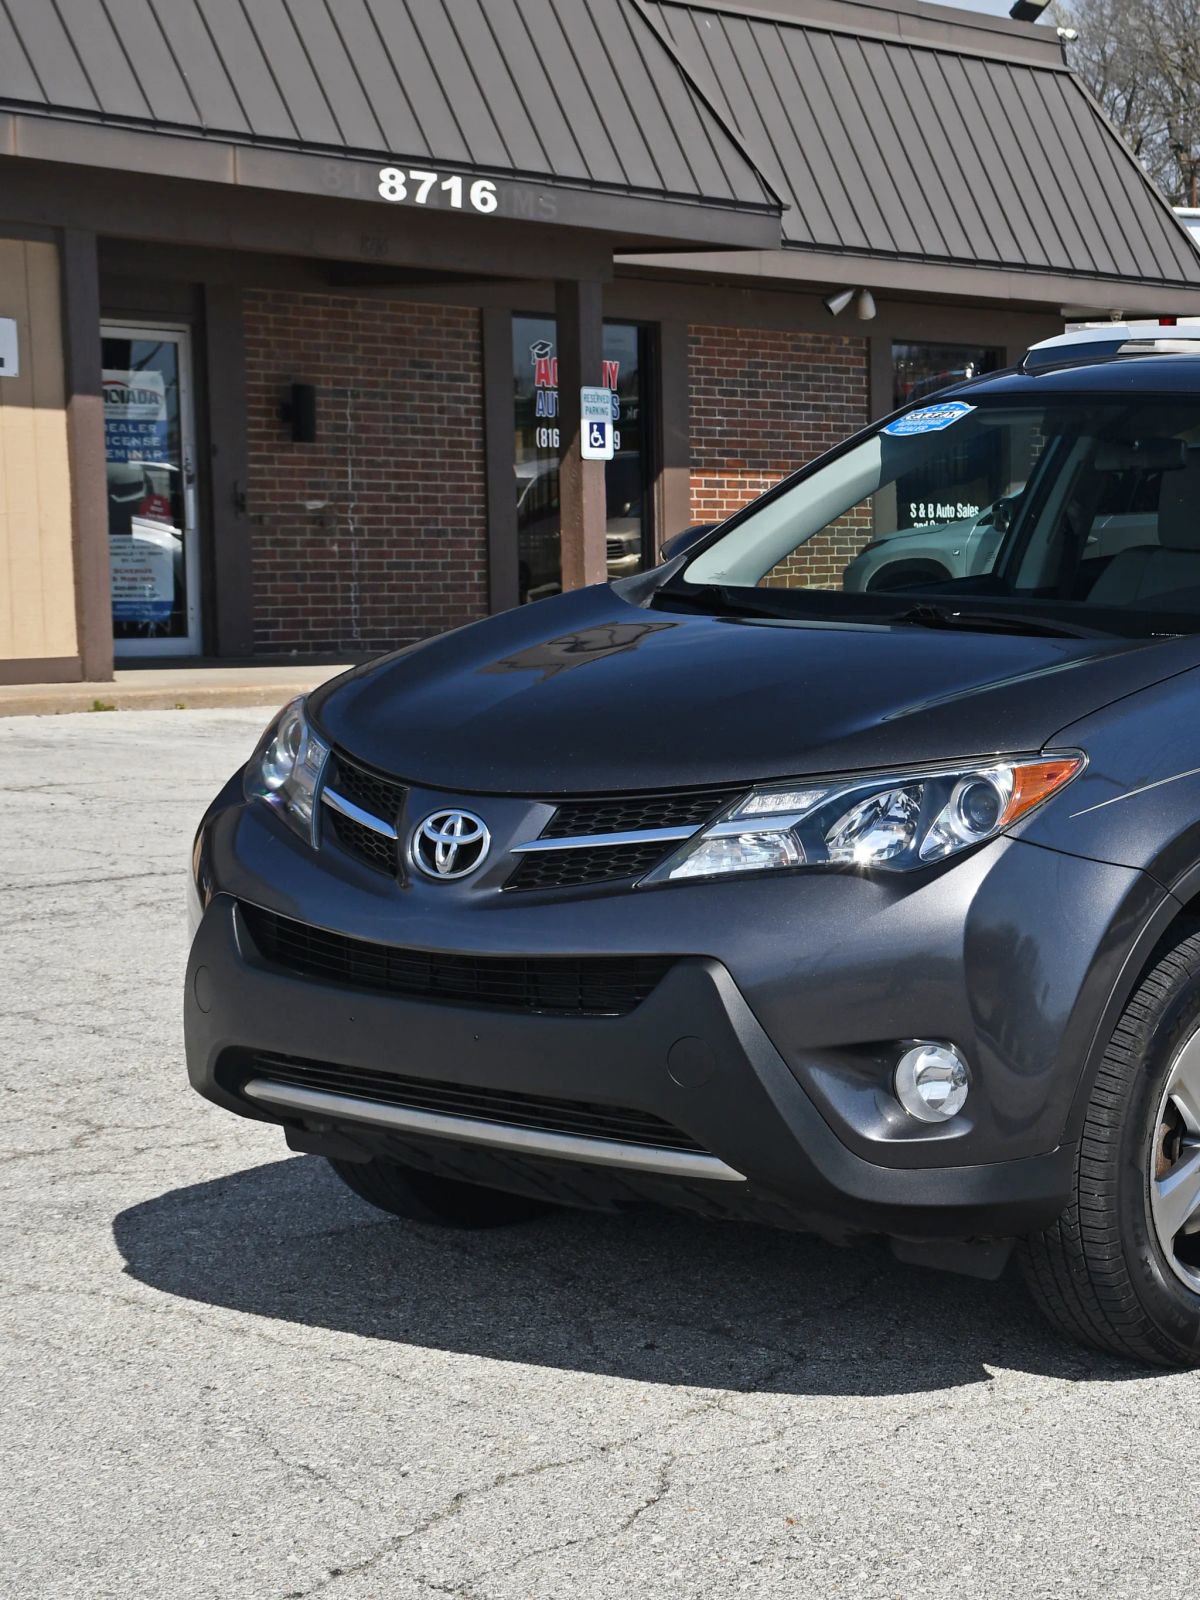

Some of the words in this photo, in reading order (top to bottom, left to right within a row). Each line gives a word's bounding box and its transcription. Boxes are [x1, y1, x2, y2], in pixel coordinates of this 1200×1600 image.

[378, 167, 498, 213] 8716
[583, 393, 610, 404] RESERVED
[585, 406, 609, 416] PARKING
[106, 436, 160, 446] ICENSE
[536, 427, 560, 448] (816
[106, 449, 163, 458] EMINAR
[910, 503, 917, 518] S
[919, 503, 926, 518] &
[928, 503, 934, 518] B
[936, 503, 955, 518] Auto
[957, 503, 979, 518] Sales
